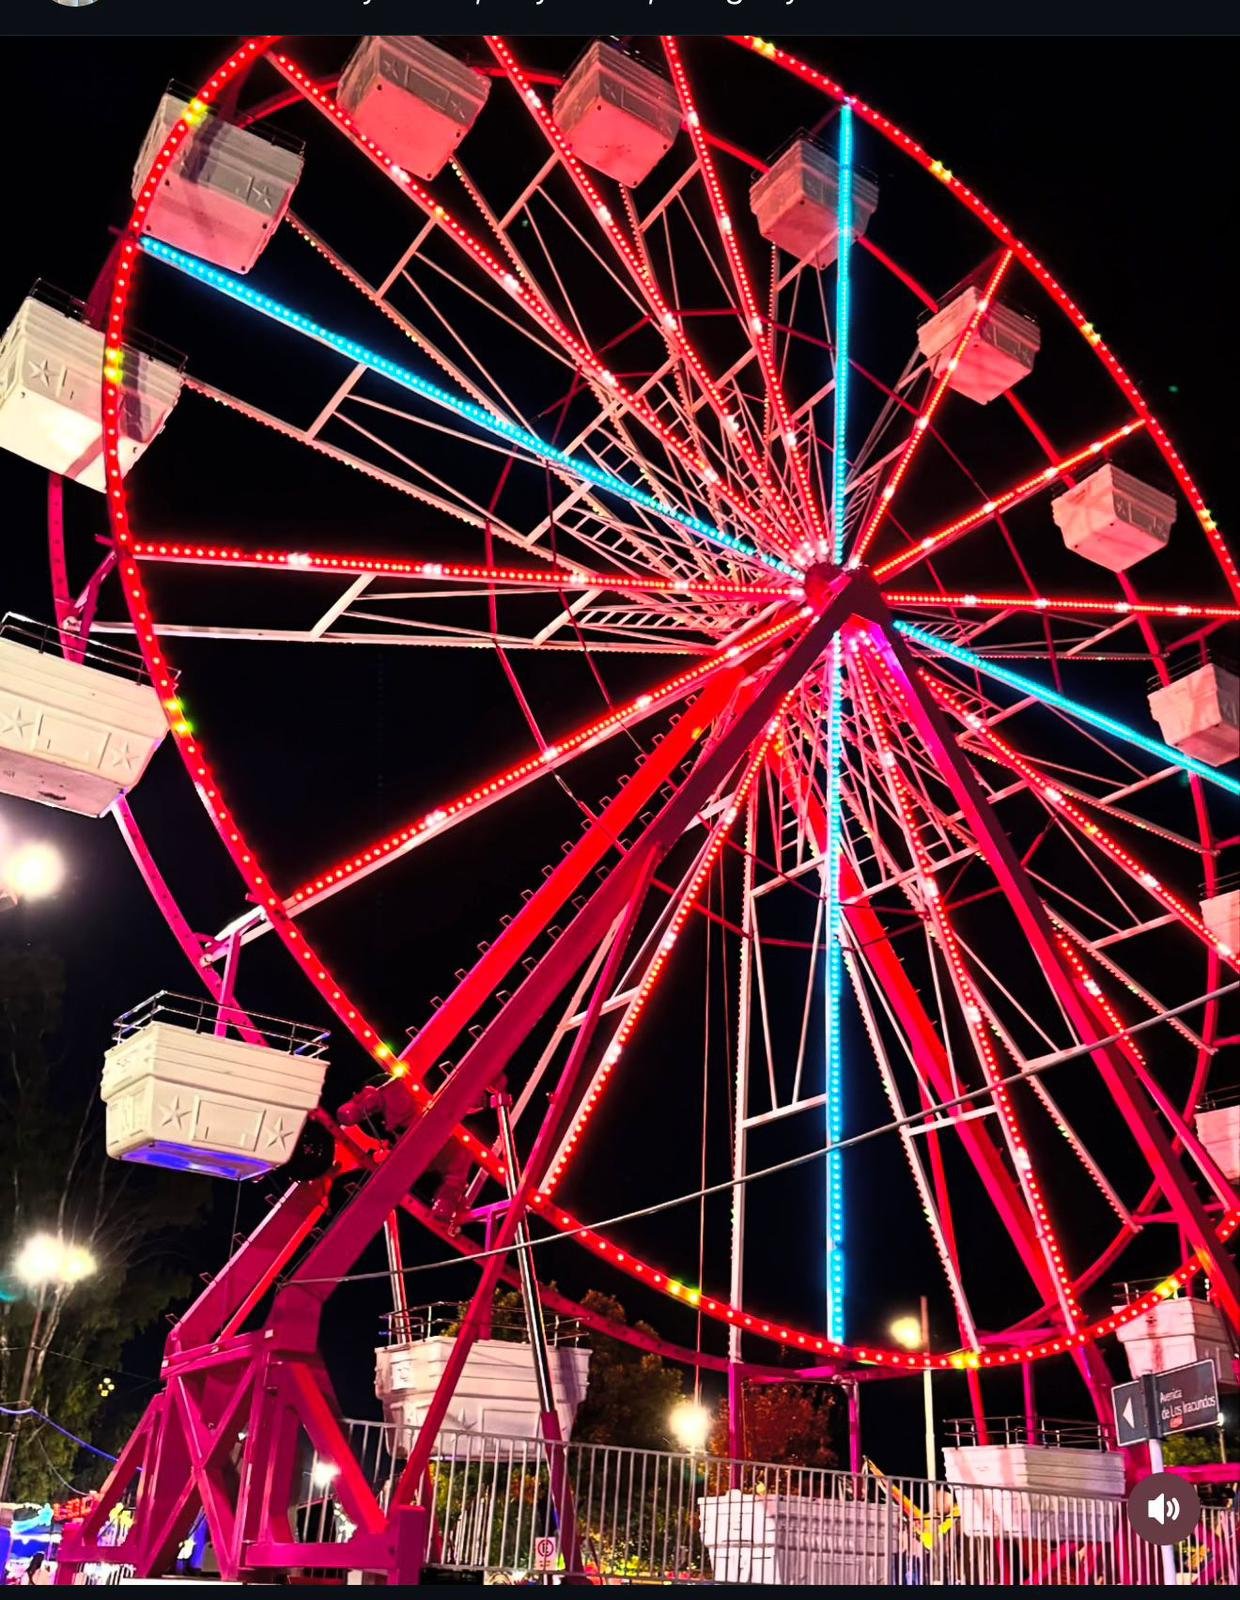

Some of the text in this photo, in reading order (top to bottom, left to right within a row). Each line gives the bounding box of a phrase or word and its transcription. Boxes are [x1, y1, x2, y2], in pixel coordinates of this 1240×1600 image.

[1161, 1395, 1215, 1420] de Los Iracundos
